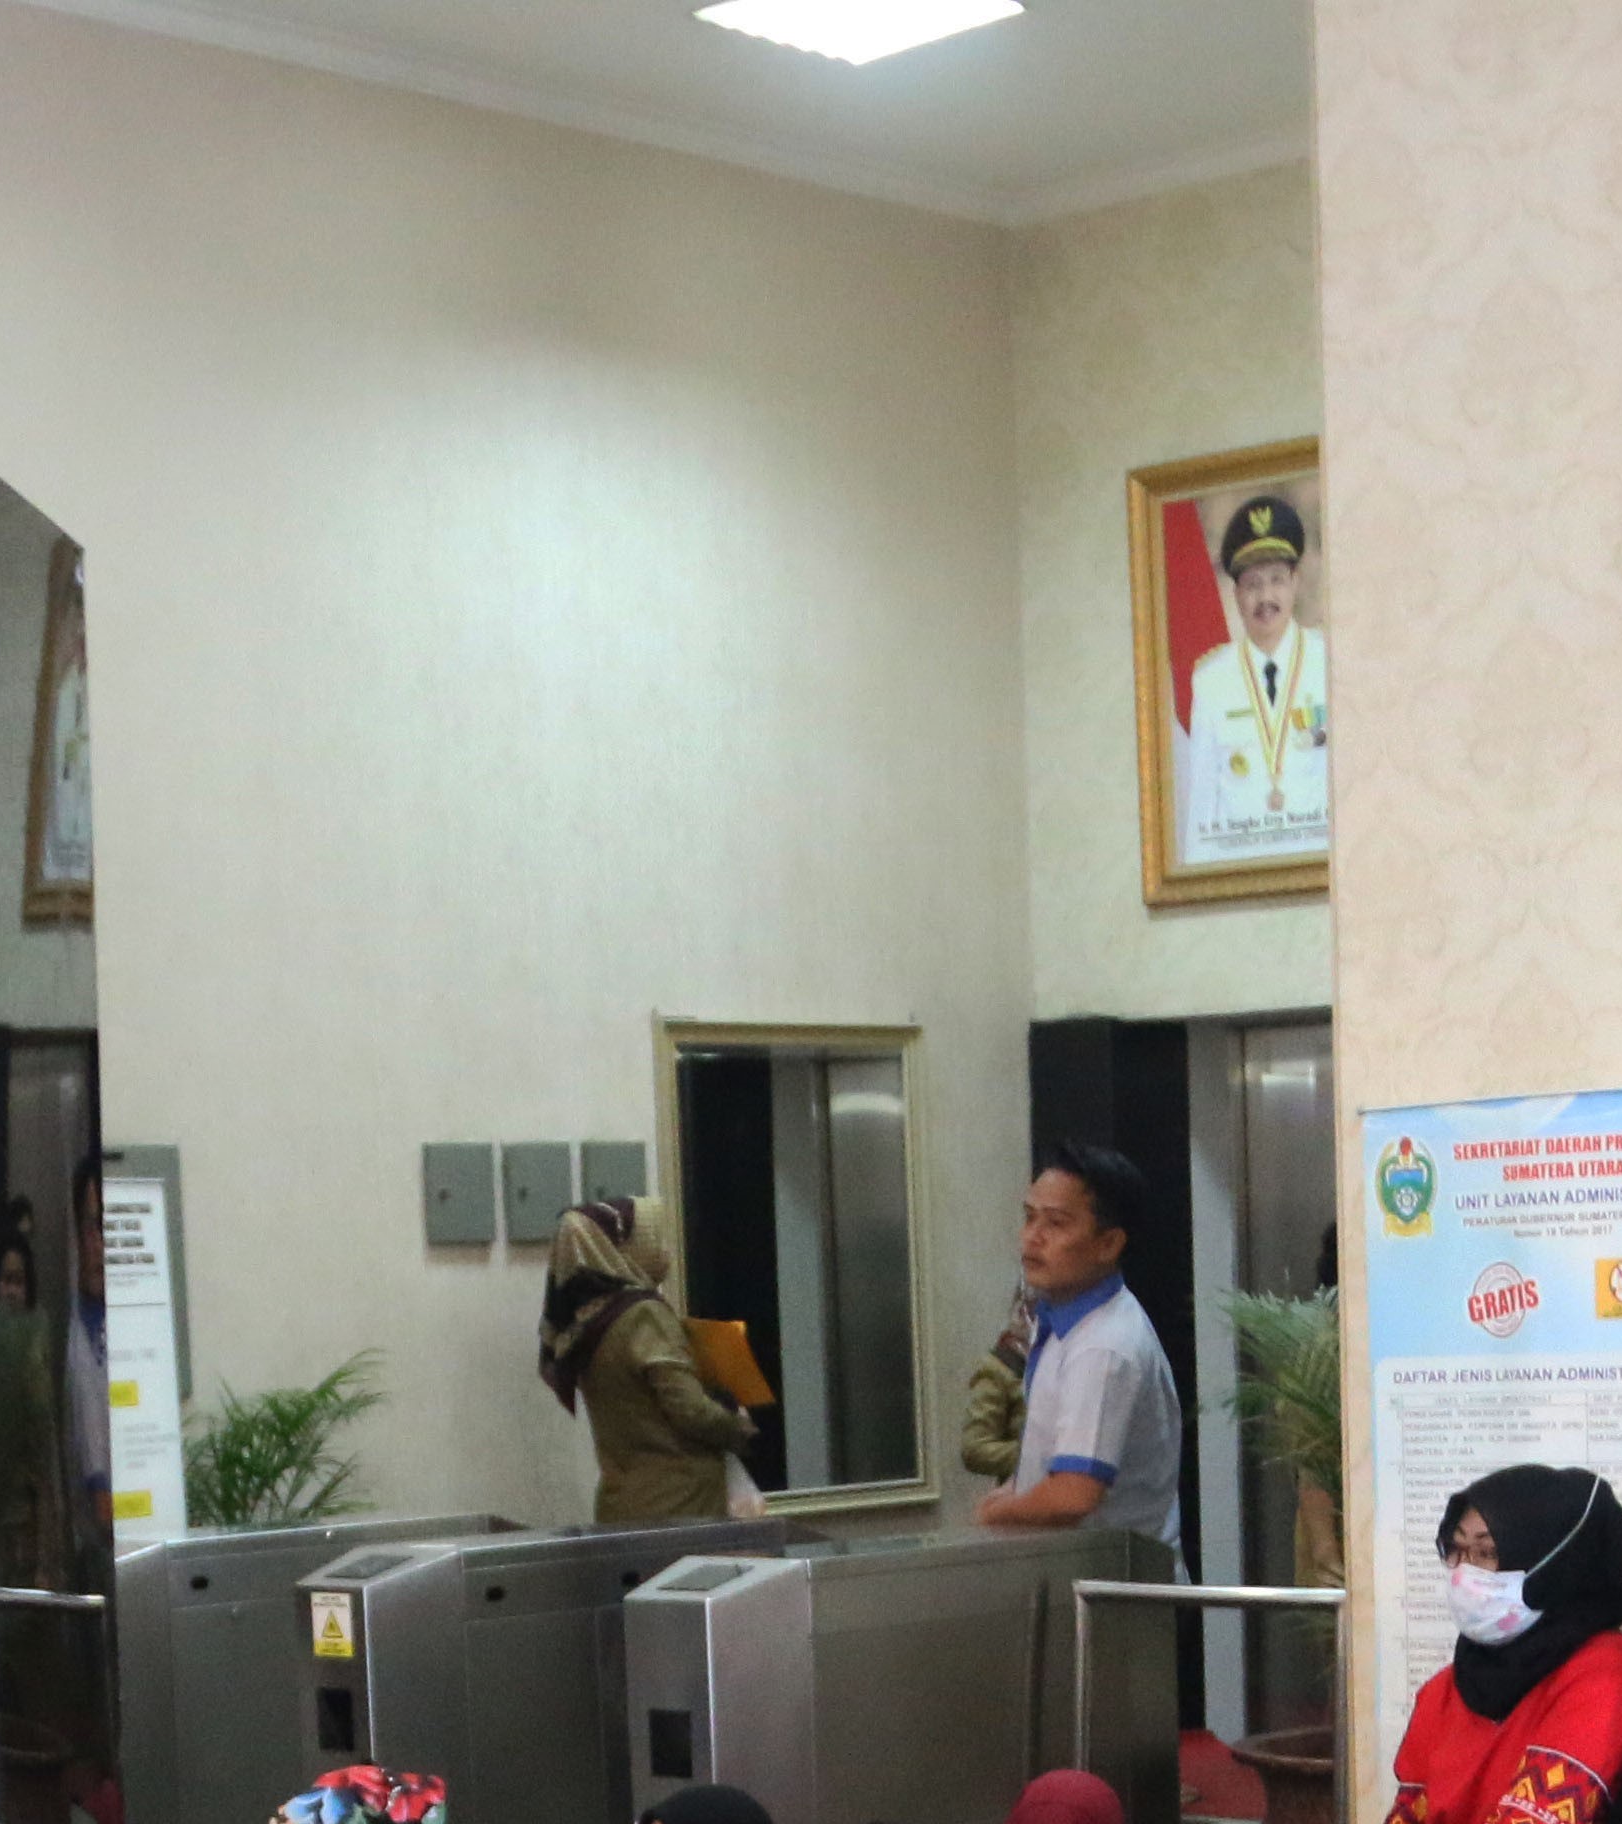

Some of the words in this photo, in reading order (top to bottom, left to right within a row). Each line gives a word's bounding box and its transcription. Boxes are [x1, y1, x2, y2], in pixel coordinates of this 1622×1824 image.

[1453, 1138, 1542, 1161] SEKRETARIAT
[1545, 1134, 1601, 1154] DAERAH
[1502, 1161, 1574, 1181] SUMATERA
[1455, 1193, 1489, 1210] UNIT
[1495, 1190, 1560, 1207] LAYANAN
[1468, 1280, 1539, 1322] GRATIS
[1393, 1370, 1447, 1384] DAFTAR
[1452, 1369, 1492, 1383] JENIS
[1496, 1367, 1552, 1382] LAYANAN
